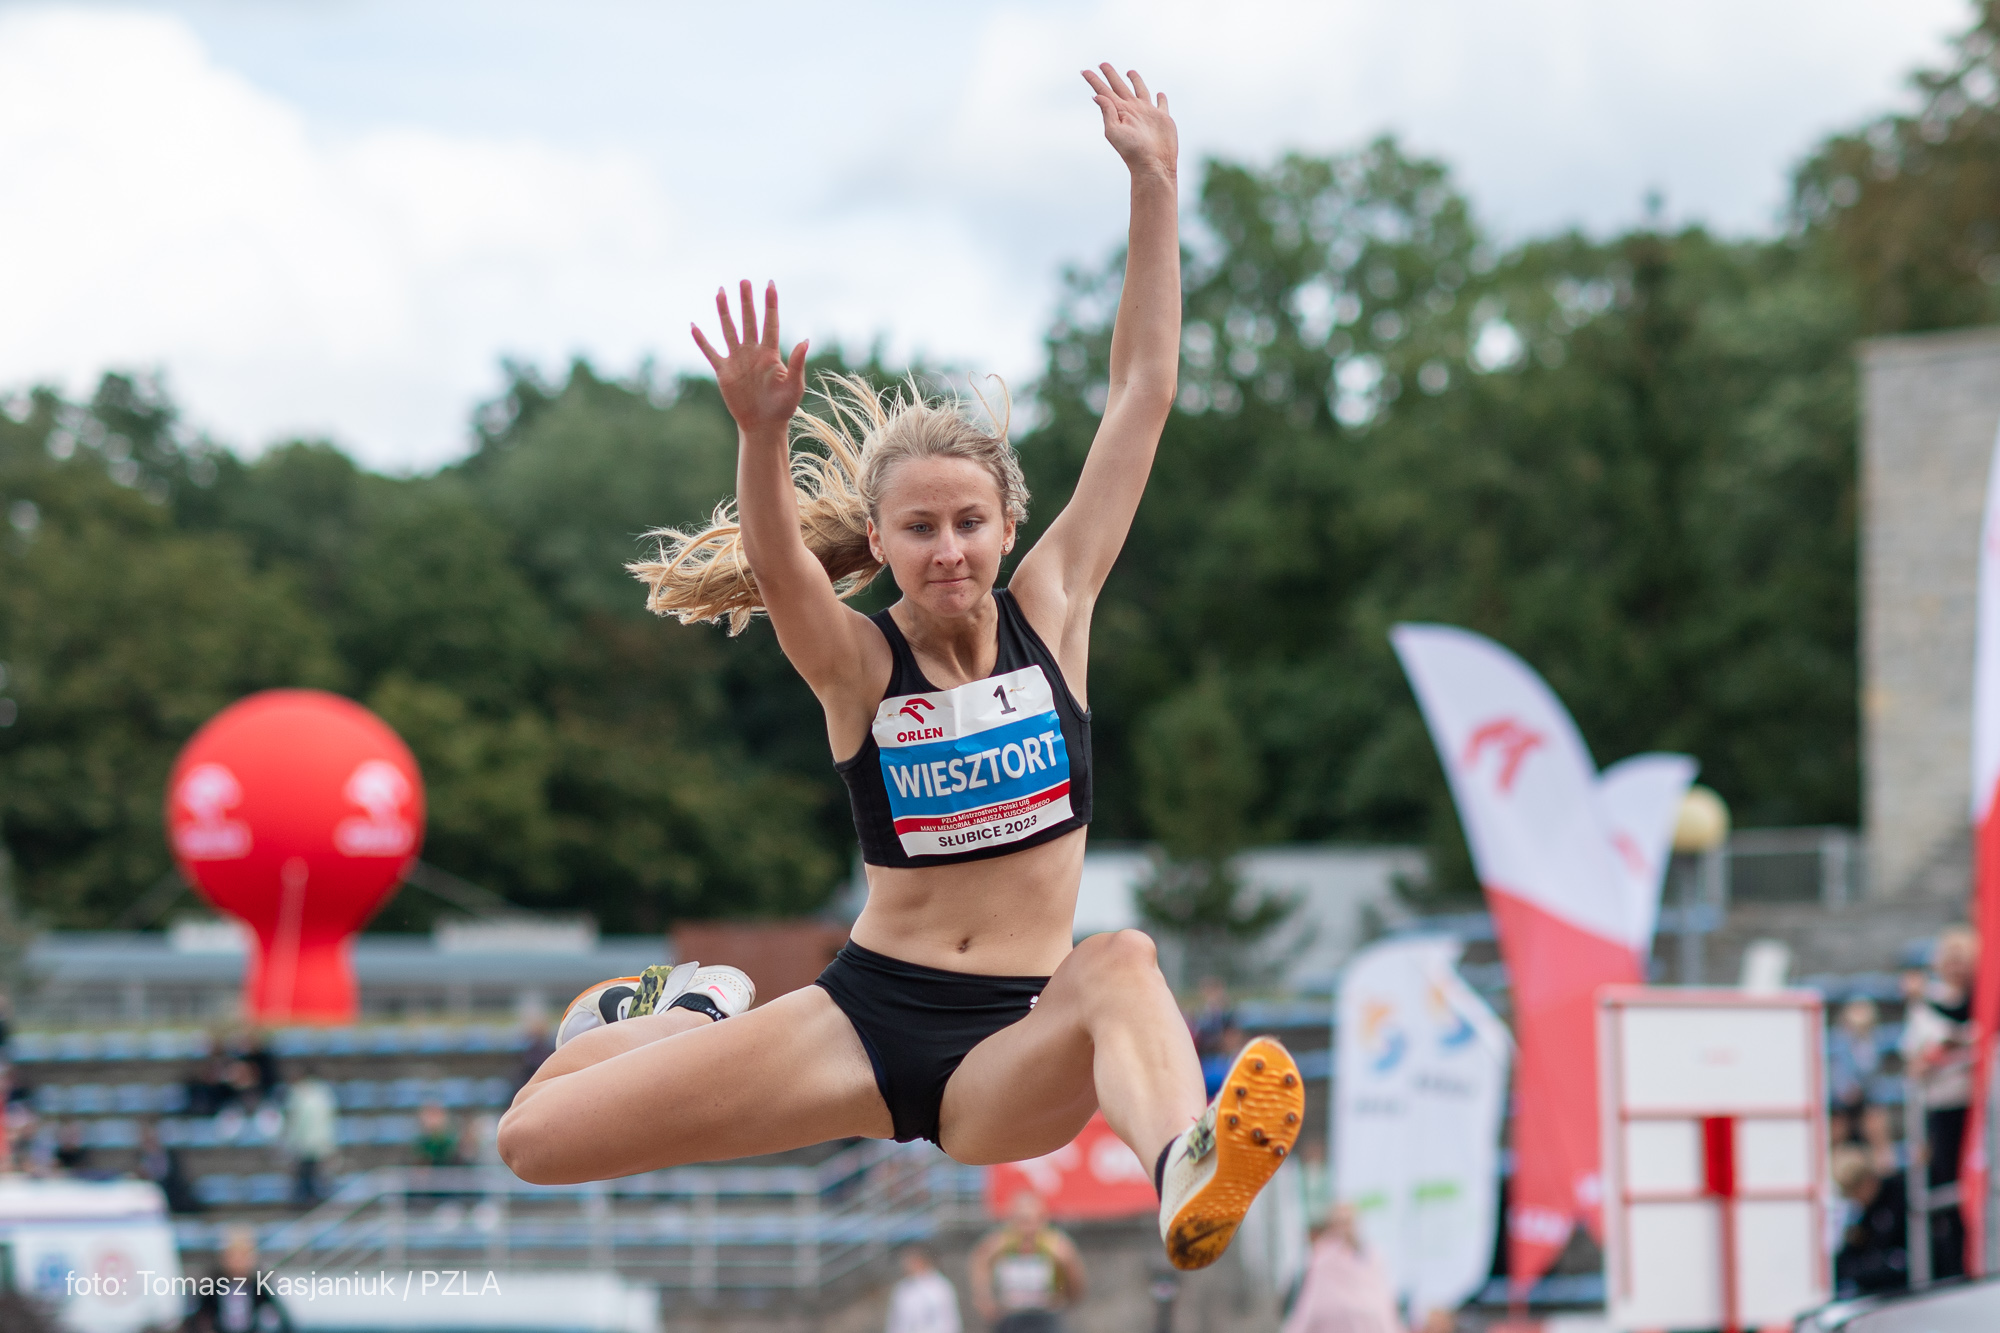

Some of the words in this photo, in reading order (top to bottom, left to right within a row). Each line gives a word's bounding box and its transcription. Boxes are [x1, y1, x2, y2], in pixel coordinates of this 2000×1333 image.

[993, 685, 1017, 715] 1
[897, 726, 943, 743] ORLEN
[888, 730, 1057, 798] WIESZTORT
[941, 815, 958, 824] PZLA
[958, 808, 998, 821] Mistrzostwa
[999, 803, 1018, 812] Polski
[1018, 799, 1030, 807] U16
[972, 813, 1002, 825] JANUSZA
[1003, 798, 1051, 817] KUSOCIŃSKIEGO
[938, 826, 1002, 847] SŁUBICE
[1004, 815, 1037, 835] 2023
